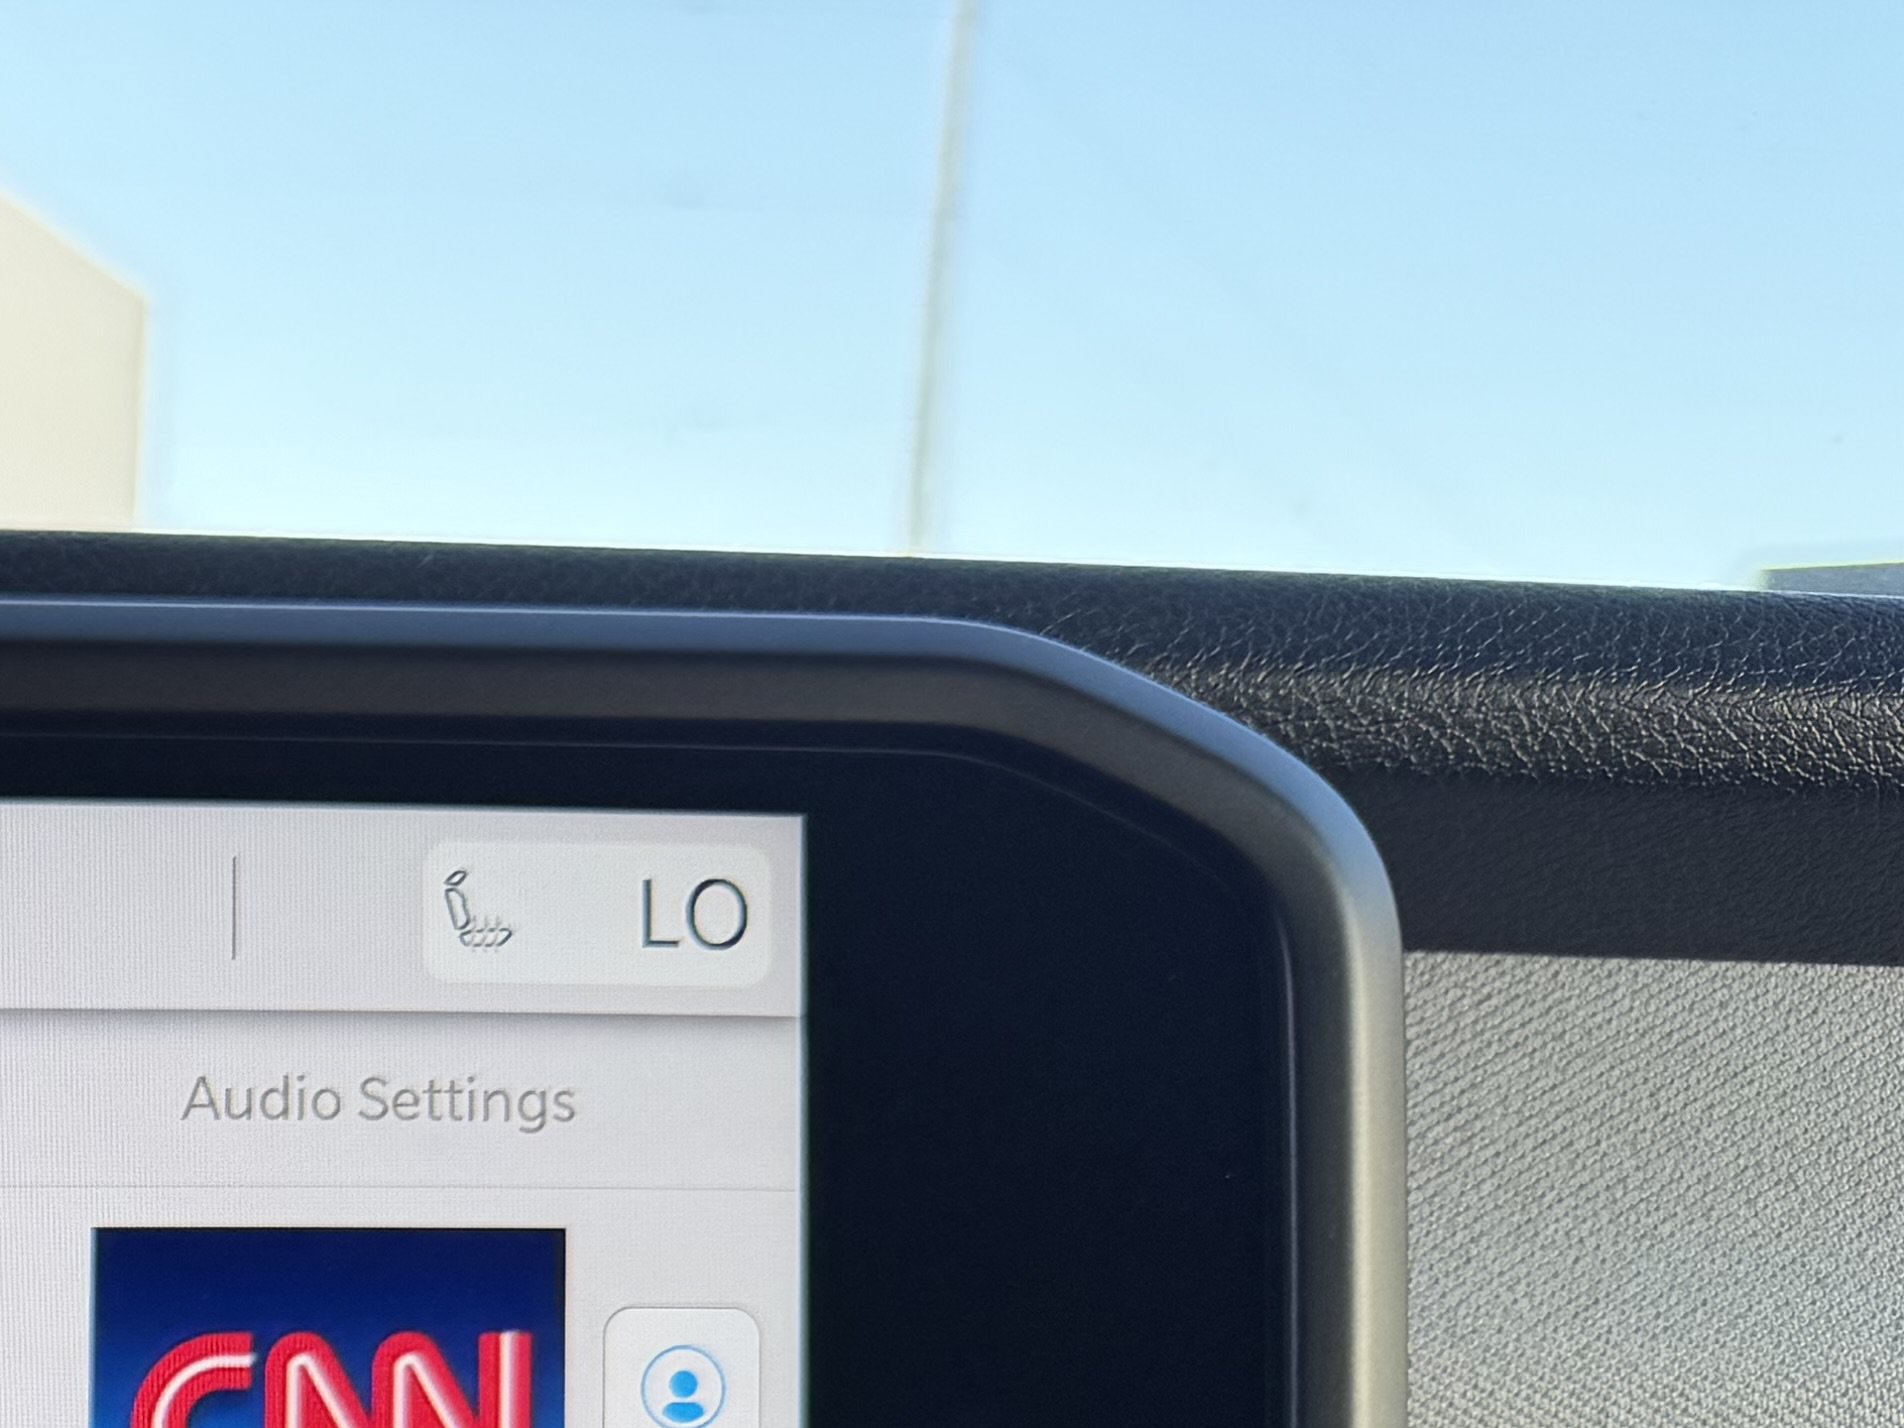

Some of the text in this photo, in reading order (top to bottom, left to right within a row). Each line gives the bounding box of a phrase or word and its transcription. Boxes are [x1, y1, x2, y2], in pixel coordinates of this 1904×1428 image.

[641, 878, 749, 950] LO
[181, 1075, 576, 1132] Audio Settings
